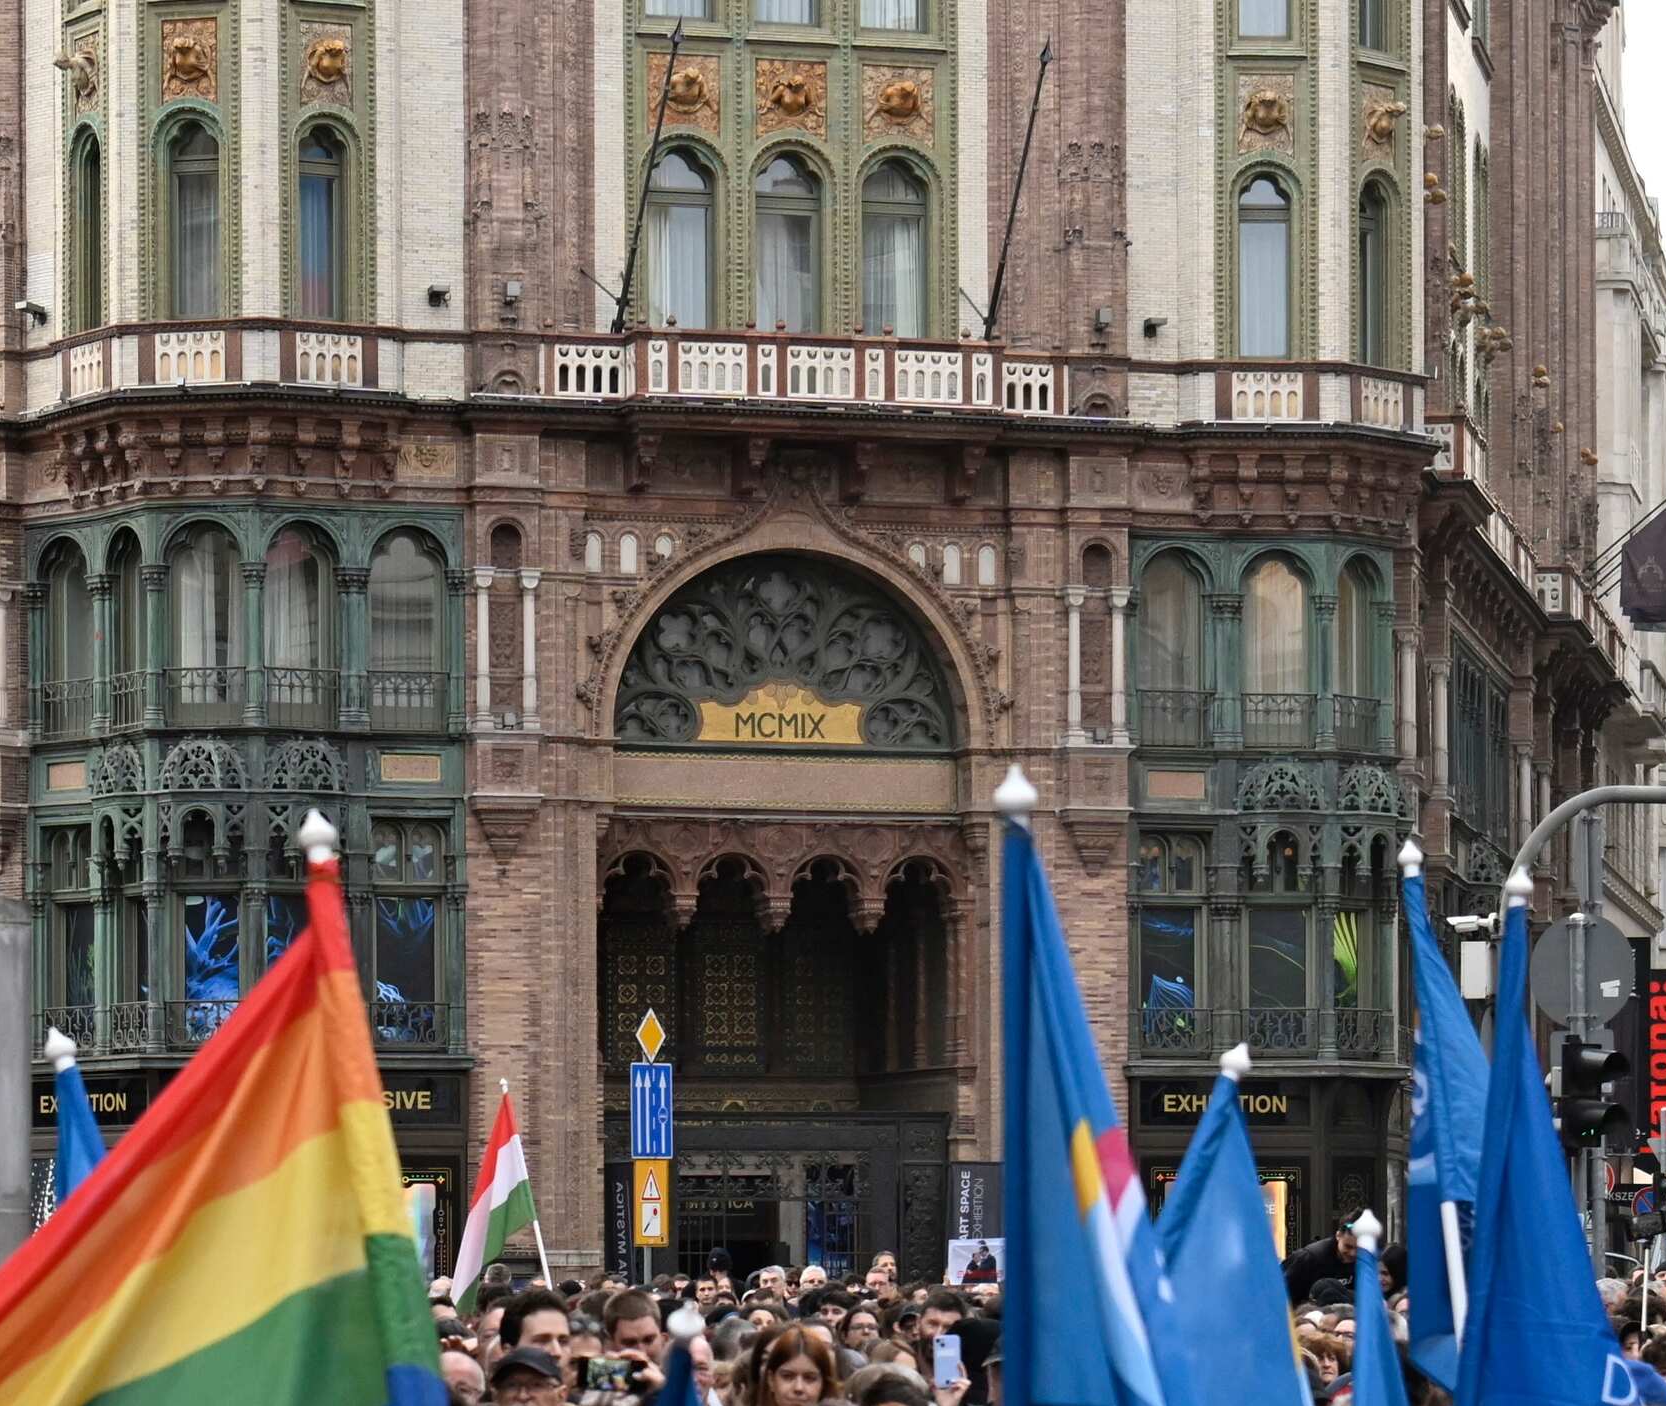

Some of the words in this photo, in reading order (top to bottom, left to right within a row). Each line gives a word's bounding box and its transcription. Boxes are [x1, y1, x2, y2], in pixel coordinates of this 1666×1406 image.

[735, 711, 826, 739] MCMIX
[40, 1092, 127, 1114] EXTION
[1163, 1094, 1287, 1113] EXHTION
[959, 1170, 971, 1213] SPACE
[958, 1216, 970, 1240] ART
